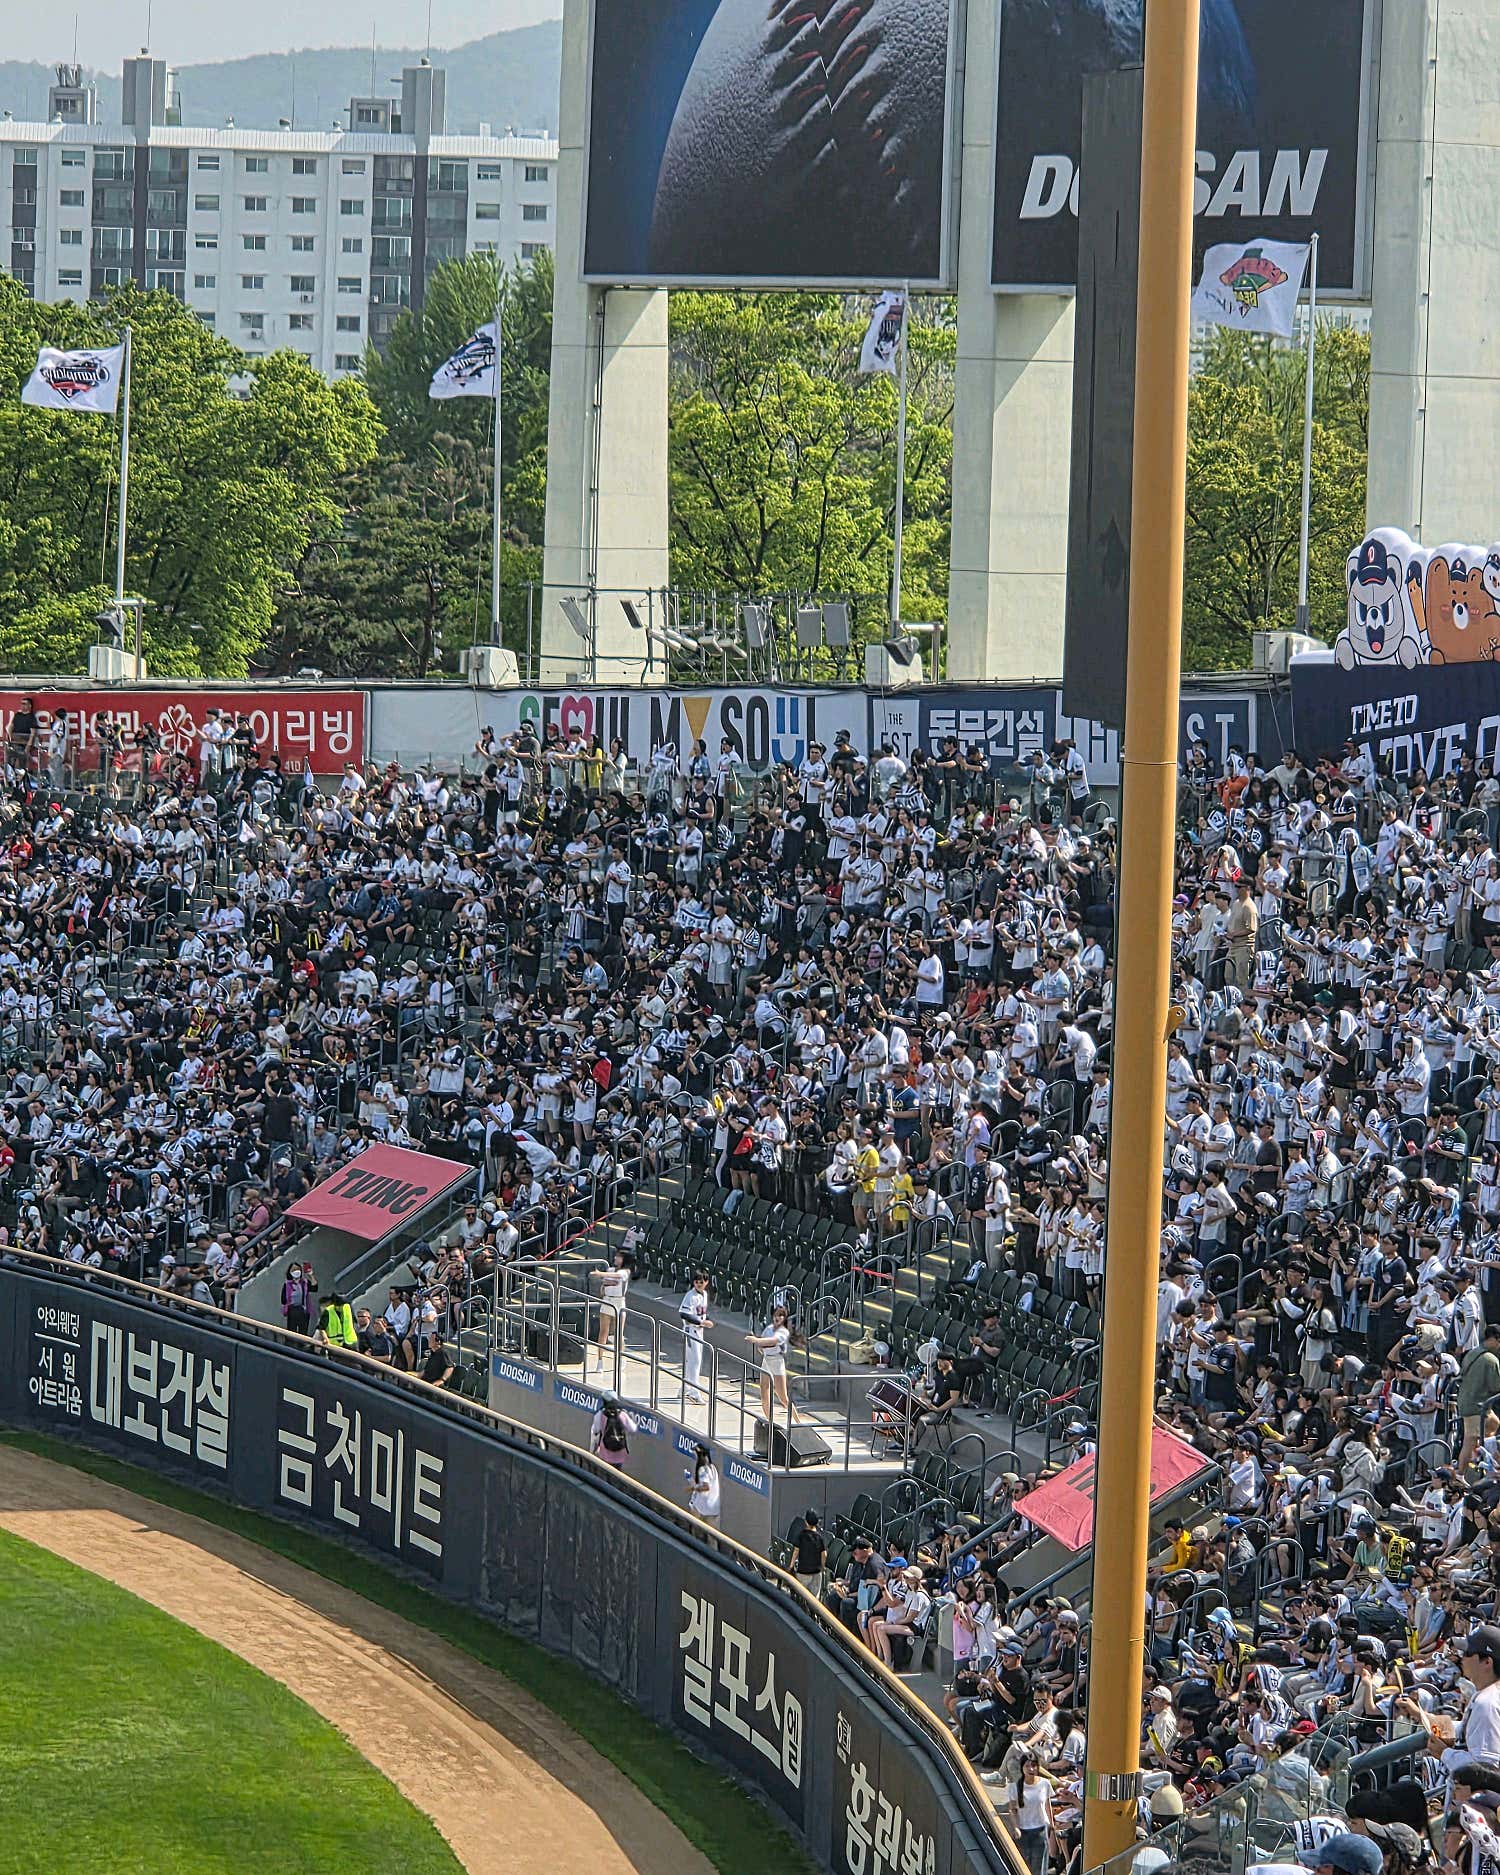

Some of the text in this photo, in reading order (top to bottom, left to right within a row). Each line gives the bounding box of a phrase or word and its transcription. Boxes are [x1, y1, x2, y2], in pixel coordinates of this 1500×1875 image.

[1019, 149, 1329, 219] DSAN
[218, 709, 353, 754] 이리빙
[888, 712, 903, 725] THE
[1351, 694, 1417, 735] TIME TO
[928, 709, 1044, 763] 동문건설
[328, 1168, 428, 1214] TVING
[37, 1306, 80, 1338] 야외웨딩
[90, 1320, 230, 1469] 대보건설
[499, 1362, 536, 1387] DOOSAN
[28, 1375, 83, 1417] 아트리움
[561, 1385, 599, 1411] DOOSAN
[277, 1387, 444, 1558] 금천미트
[730, 1461, 763, 1490] DOOSAN
